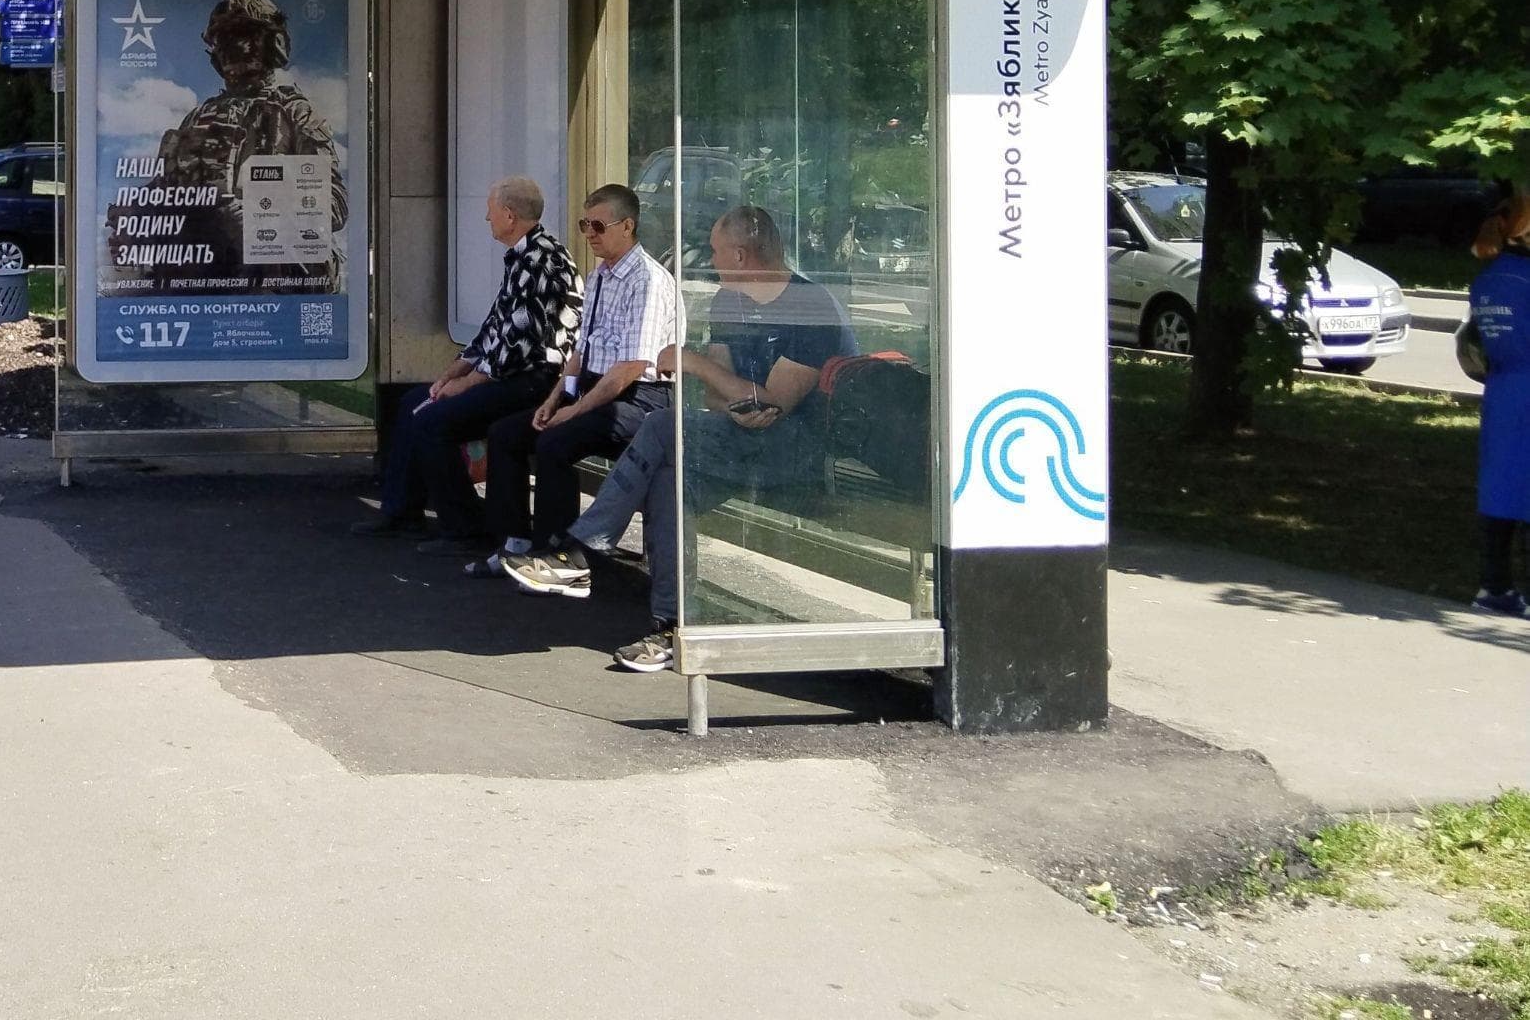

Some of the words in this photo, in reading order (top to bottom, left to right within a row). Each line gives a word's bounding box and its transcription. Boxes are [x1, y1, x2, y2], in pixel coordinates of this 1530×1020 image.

[1033, 40, 1050, 106] Metro
[115, 157, 165, 178] НАША
[115, 186, 218, 207] ПРОФЕССИЯ
[998, 147, 1027, 259] Метро
[116, 215, 186, 238] РОДИНУ
[116, 244, 214, 267] ЗАЩИЩАТЬ
[117, 279, 155, 289] УВАЖЕНИЕ
[206, 278, 249, 288] ПРОФЕССИЯ
[262, 277, 303, 287] ДОСТОЙНАЯ
[119, 304, 177, 315] СЛУЖБА
[180, 304, 200, 314] ПО
[204, 303, 281, 314] КОНТРАКТУ
[139, 321, 191, 347] 117
